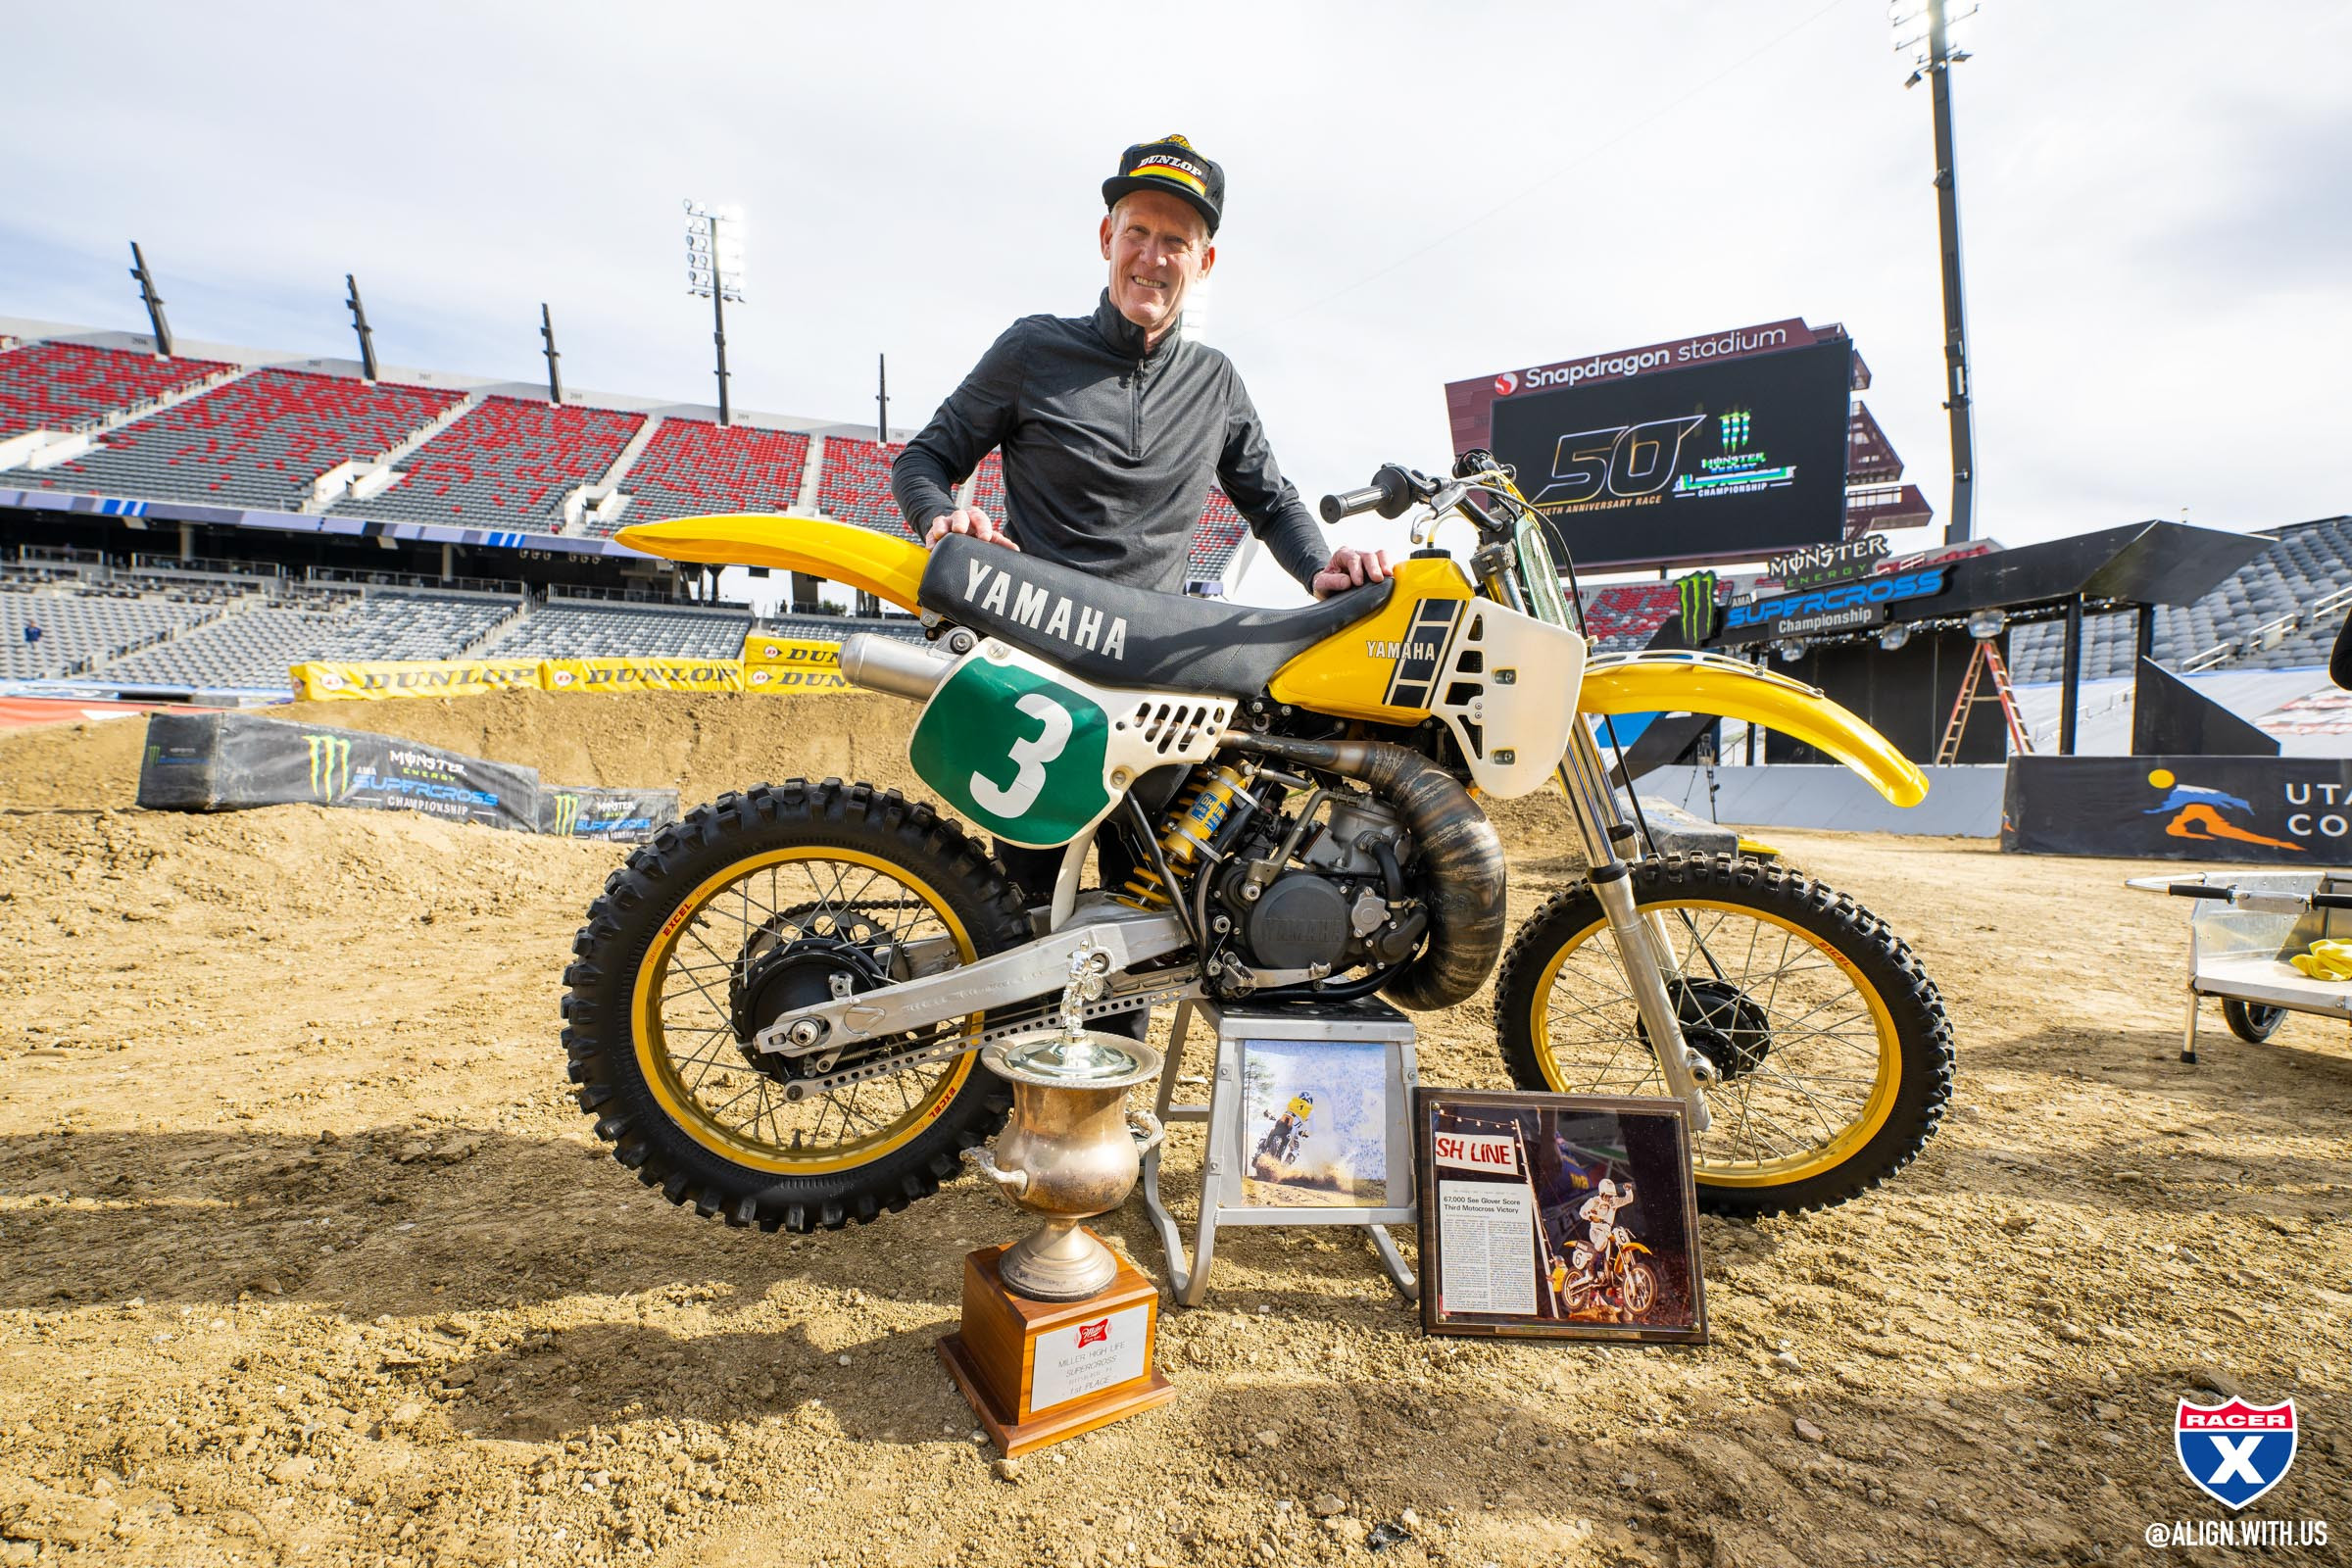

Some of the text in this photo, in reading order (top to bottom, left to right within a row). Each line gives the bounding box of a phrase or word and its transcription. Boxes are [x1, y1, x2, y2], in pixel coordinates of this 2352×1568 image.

[1137, 154, 1202, 176] DUNLOP
[1525, 327, 1788, 387] Snapdragon stadium
[1697, 482, 1768, 498] CHAMPIONSHIP
[1565, 498, 1633, 514] ANNIVERSARY
[1635, 495, 1663, 506] RACE
[1768, 537, 1888, 577] MONSTER
[1787, 564, 1868, 588] ENERGY
[963, 558, 1128, 662] YAMAHA
[1726, 569, 1944, 627] SUPERCROSS
[1732, 595, 1751, 608] AMA
[1778, 608, 1873, 634] Championship
[1366, 640, 1436, 662] YAMAHA
[359, 667, 536, 690] DUNLOP
[585, 667, 739, 685] DUNLOP
[777, 671, 857, 688] DUN
[389, 750, 468, 776] MONSTER
[969, 693, 1073, 819] 3
[356, 765, 377, 775] AMA
[403, 767, 456, 781] ENERGY
[353, 774, 500, 807] SUPERCROSS
[387, 796, 468, 815] CHAMPIONSHIP
[662, 902, 693, 937] EXCEL
[1818, 941, 1850, 968] EXCEL
[929, 1087, 956, 1118] EXCEL
[1435, 1137, 1512, 1165] SH LINE
[1496, 1205, 1519, 1214] Victory
[1618, 1230, 1627, 1244] 6
[1575, 1252, 1583, 1266] 6
[1058, 1341, 1126, 1368] MILLER HIGH LIFE
[1066, 1354, 1117, 1378] SUPERCROSS
